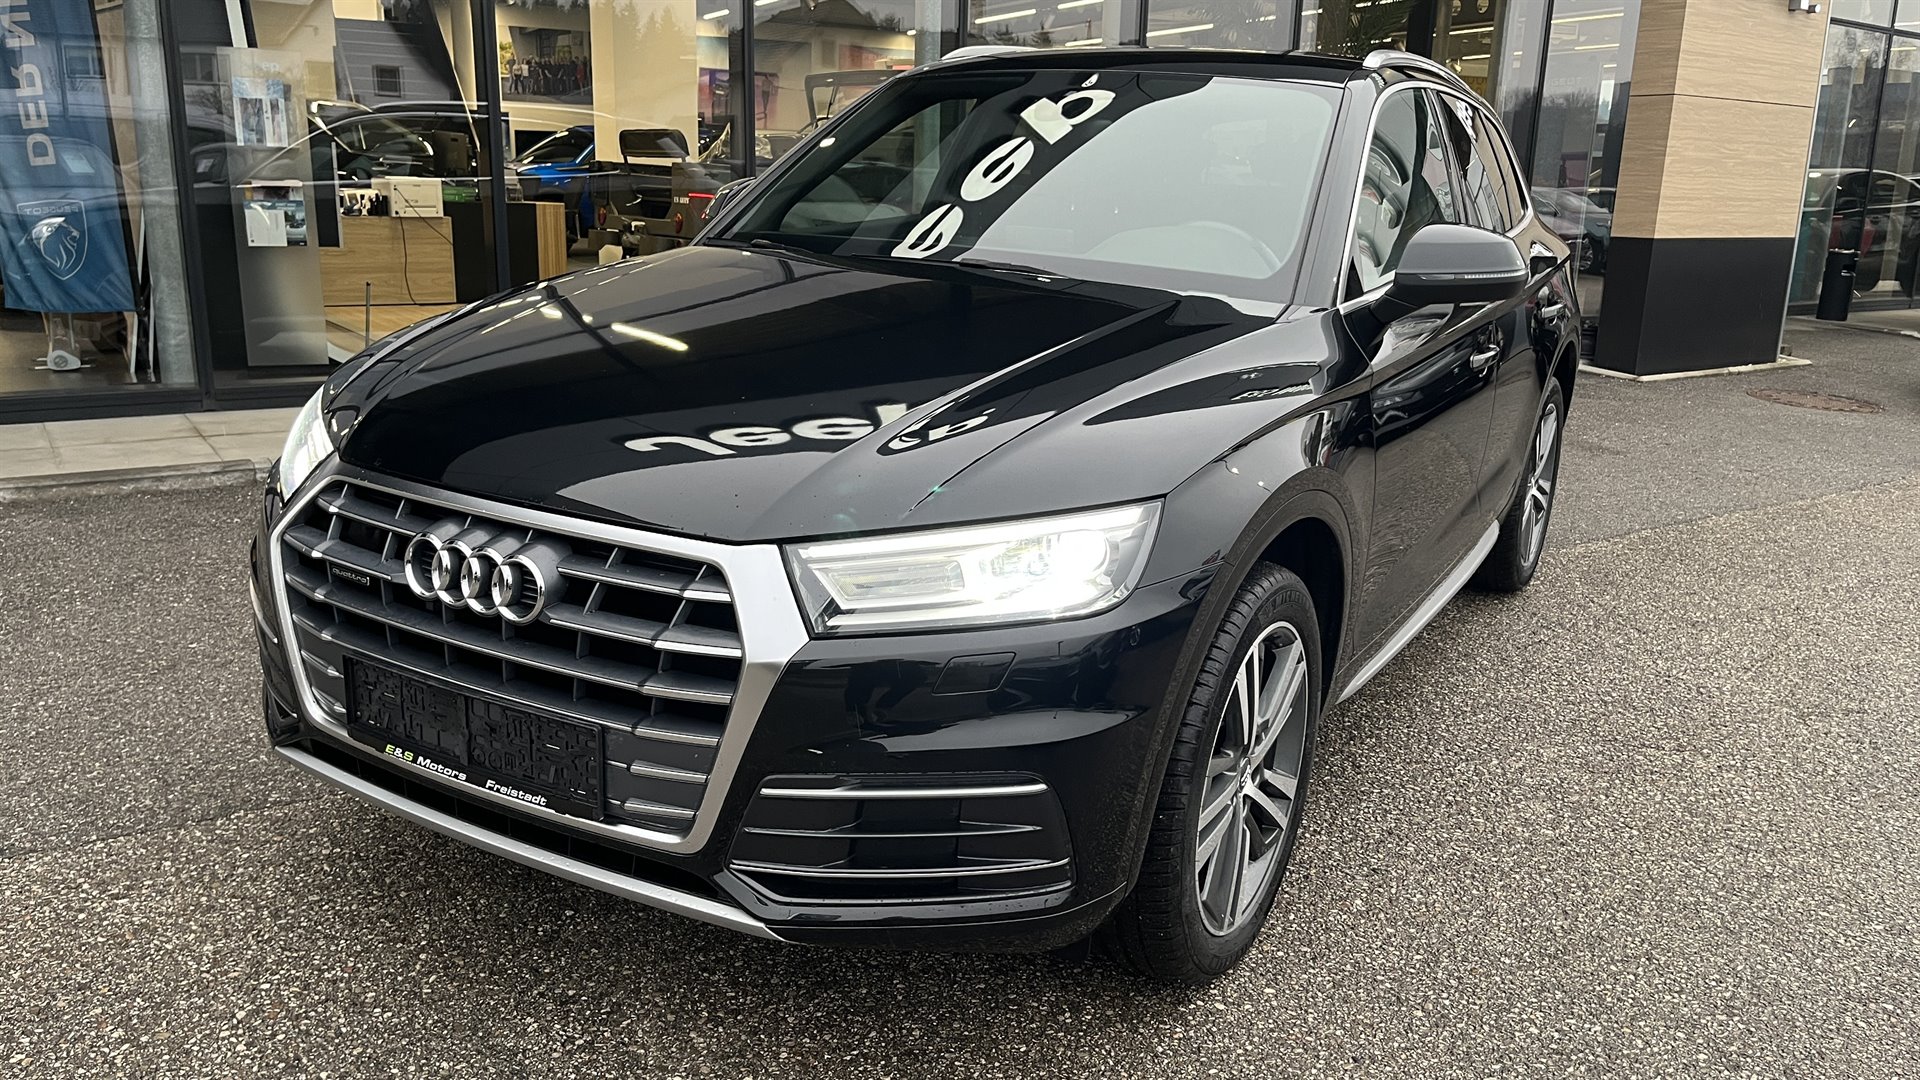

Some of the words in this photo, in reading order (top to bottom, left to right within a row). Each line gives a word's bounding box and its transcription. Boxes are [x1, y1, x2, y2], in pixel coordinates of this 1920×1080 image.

[332, 567, 367, 583] quattro
[385, 744, 414, 762] E&S
[416, 755, 468, 782] Motors
[485, 779, 548, 807] Freistadt
